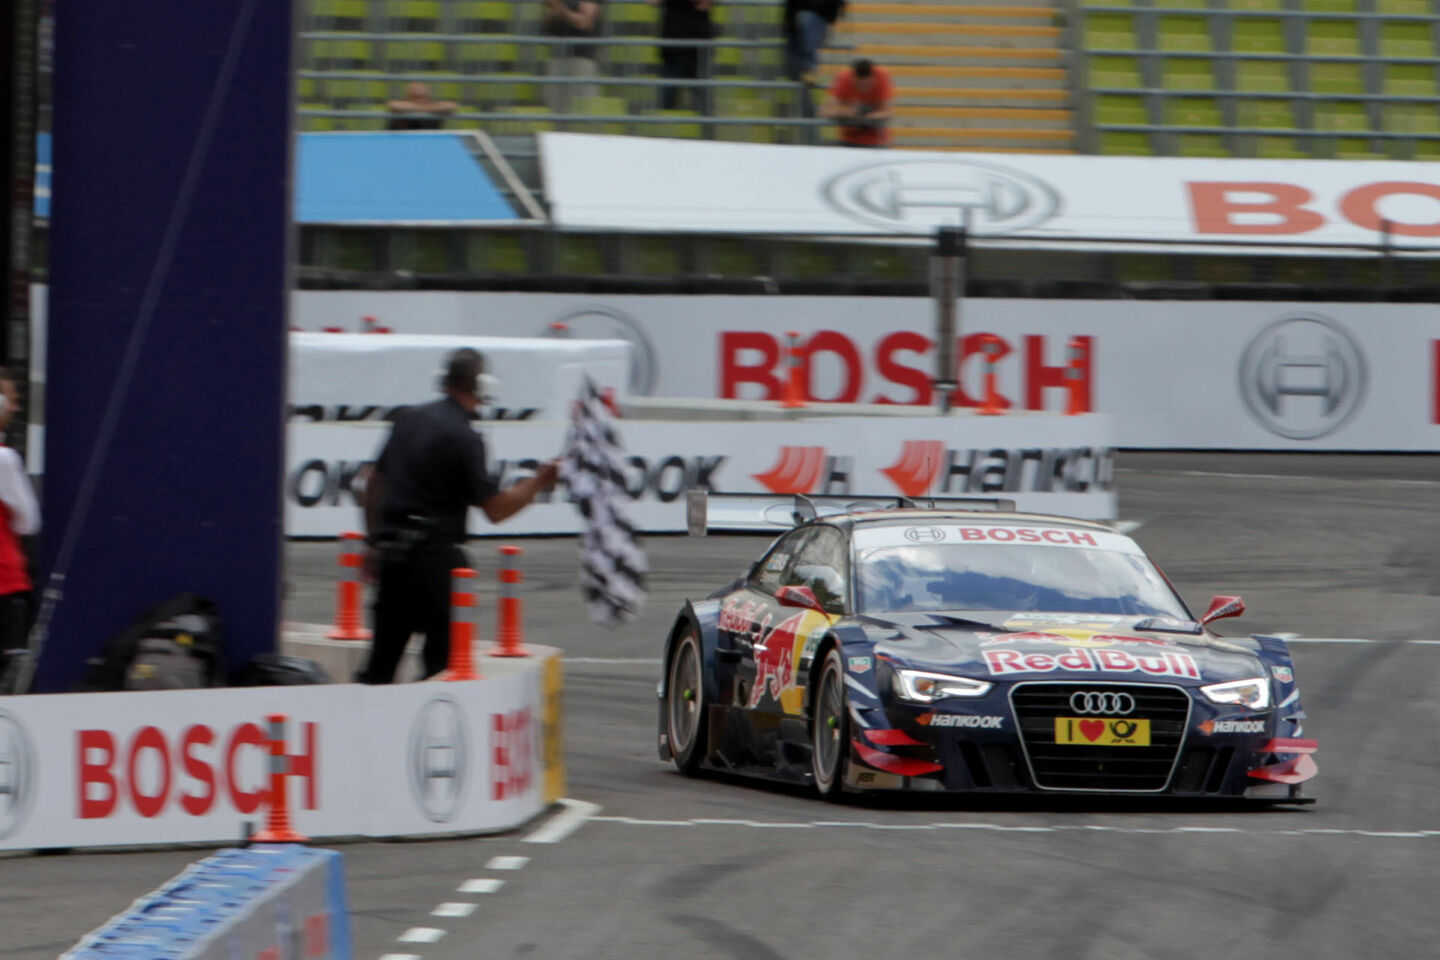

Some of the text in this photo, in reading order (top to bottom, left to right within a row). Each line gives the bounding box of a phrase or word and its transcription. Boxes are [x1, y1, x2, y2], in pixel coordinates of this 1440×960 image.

[959, 526, 1099, 547] BOSCH
[986, 648, 1198, 678] Red Bull
[76, 721, 321, 819] BOSCH
